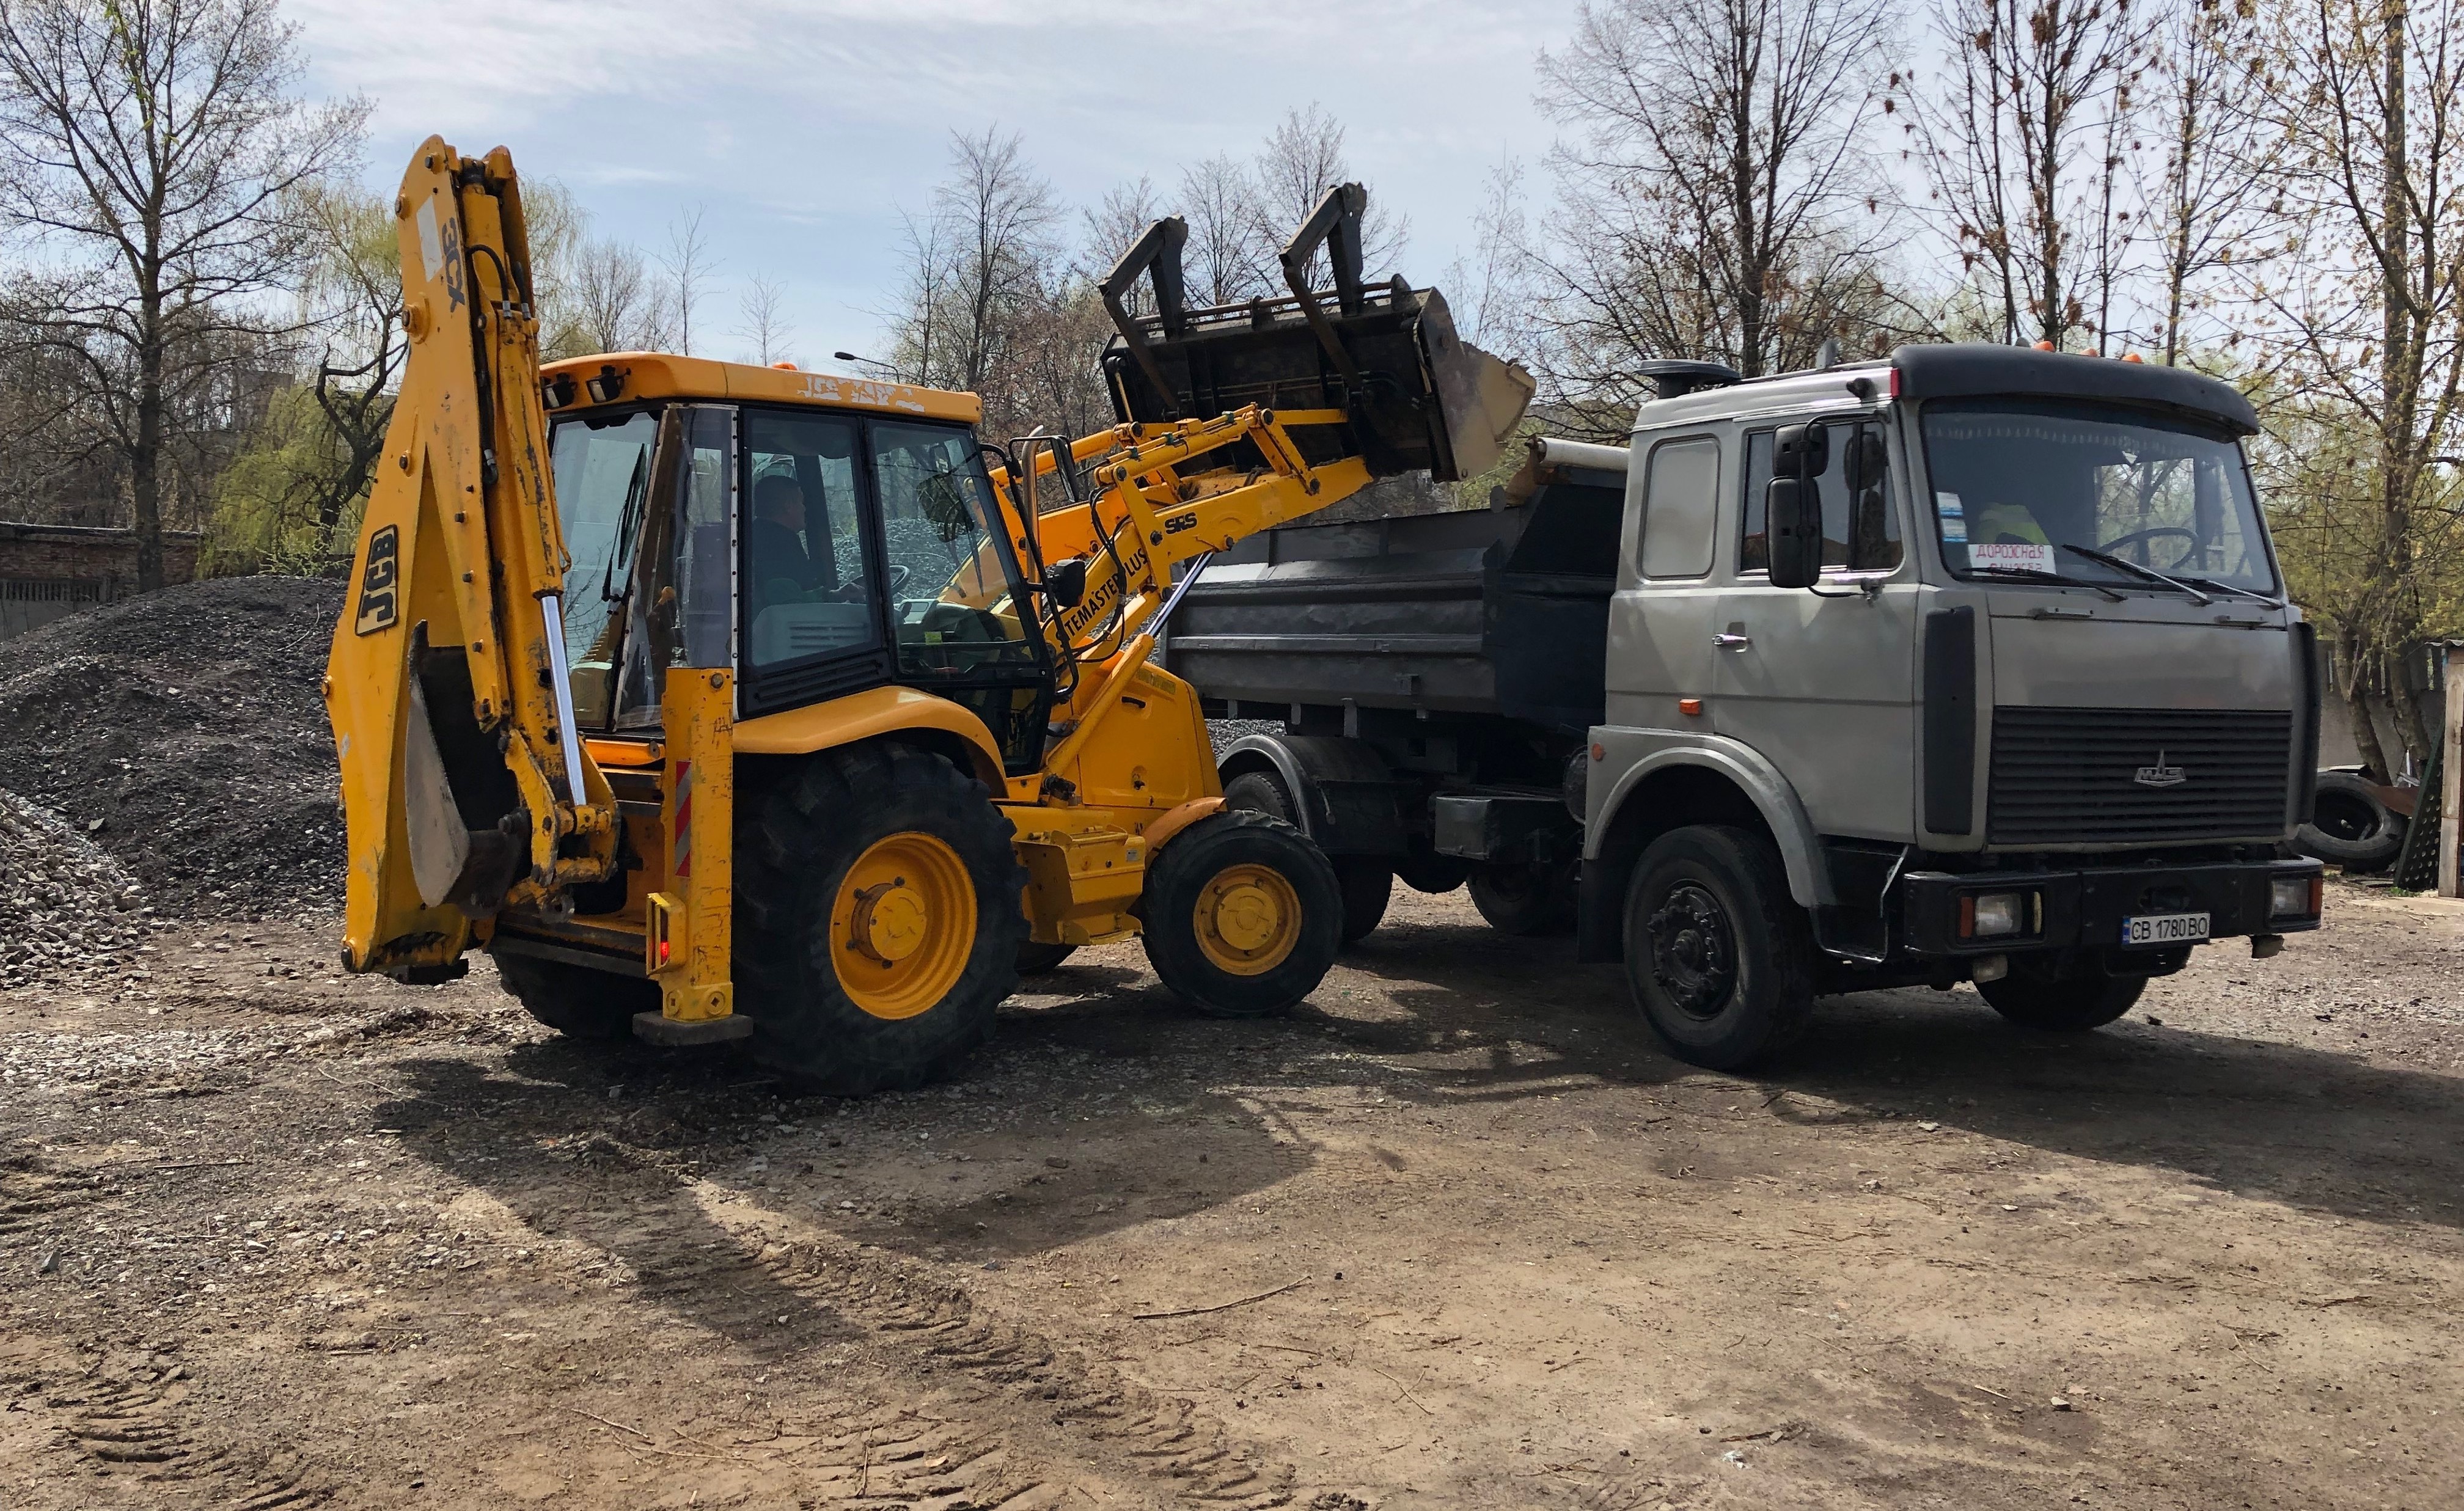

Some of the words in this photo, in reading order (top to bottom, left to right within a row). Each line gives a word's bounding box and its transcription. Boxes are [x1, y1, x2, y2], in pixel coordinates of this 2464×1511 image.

[1164, 512, 1197, 534] SRS
[1124, 548, 1148, 577] LUS
[360, 533, 394, 622] JCB
[2132, 921, 2151, 940] CB
[2156, 918, 2186, 938] 1780
